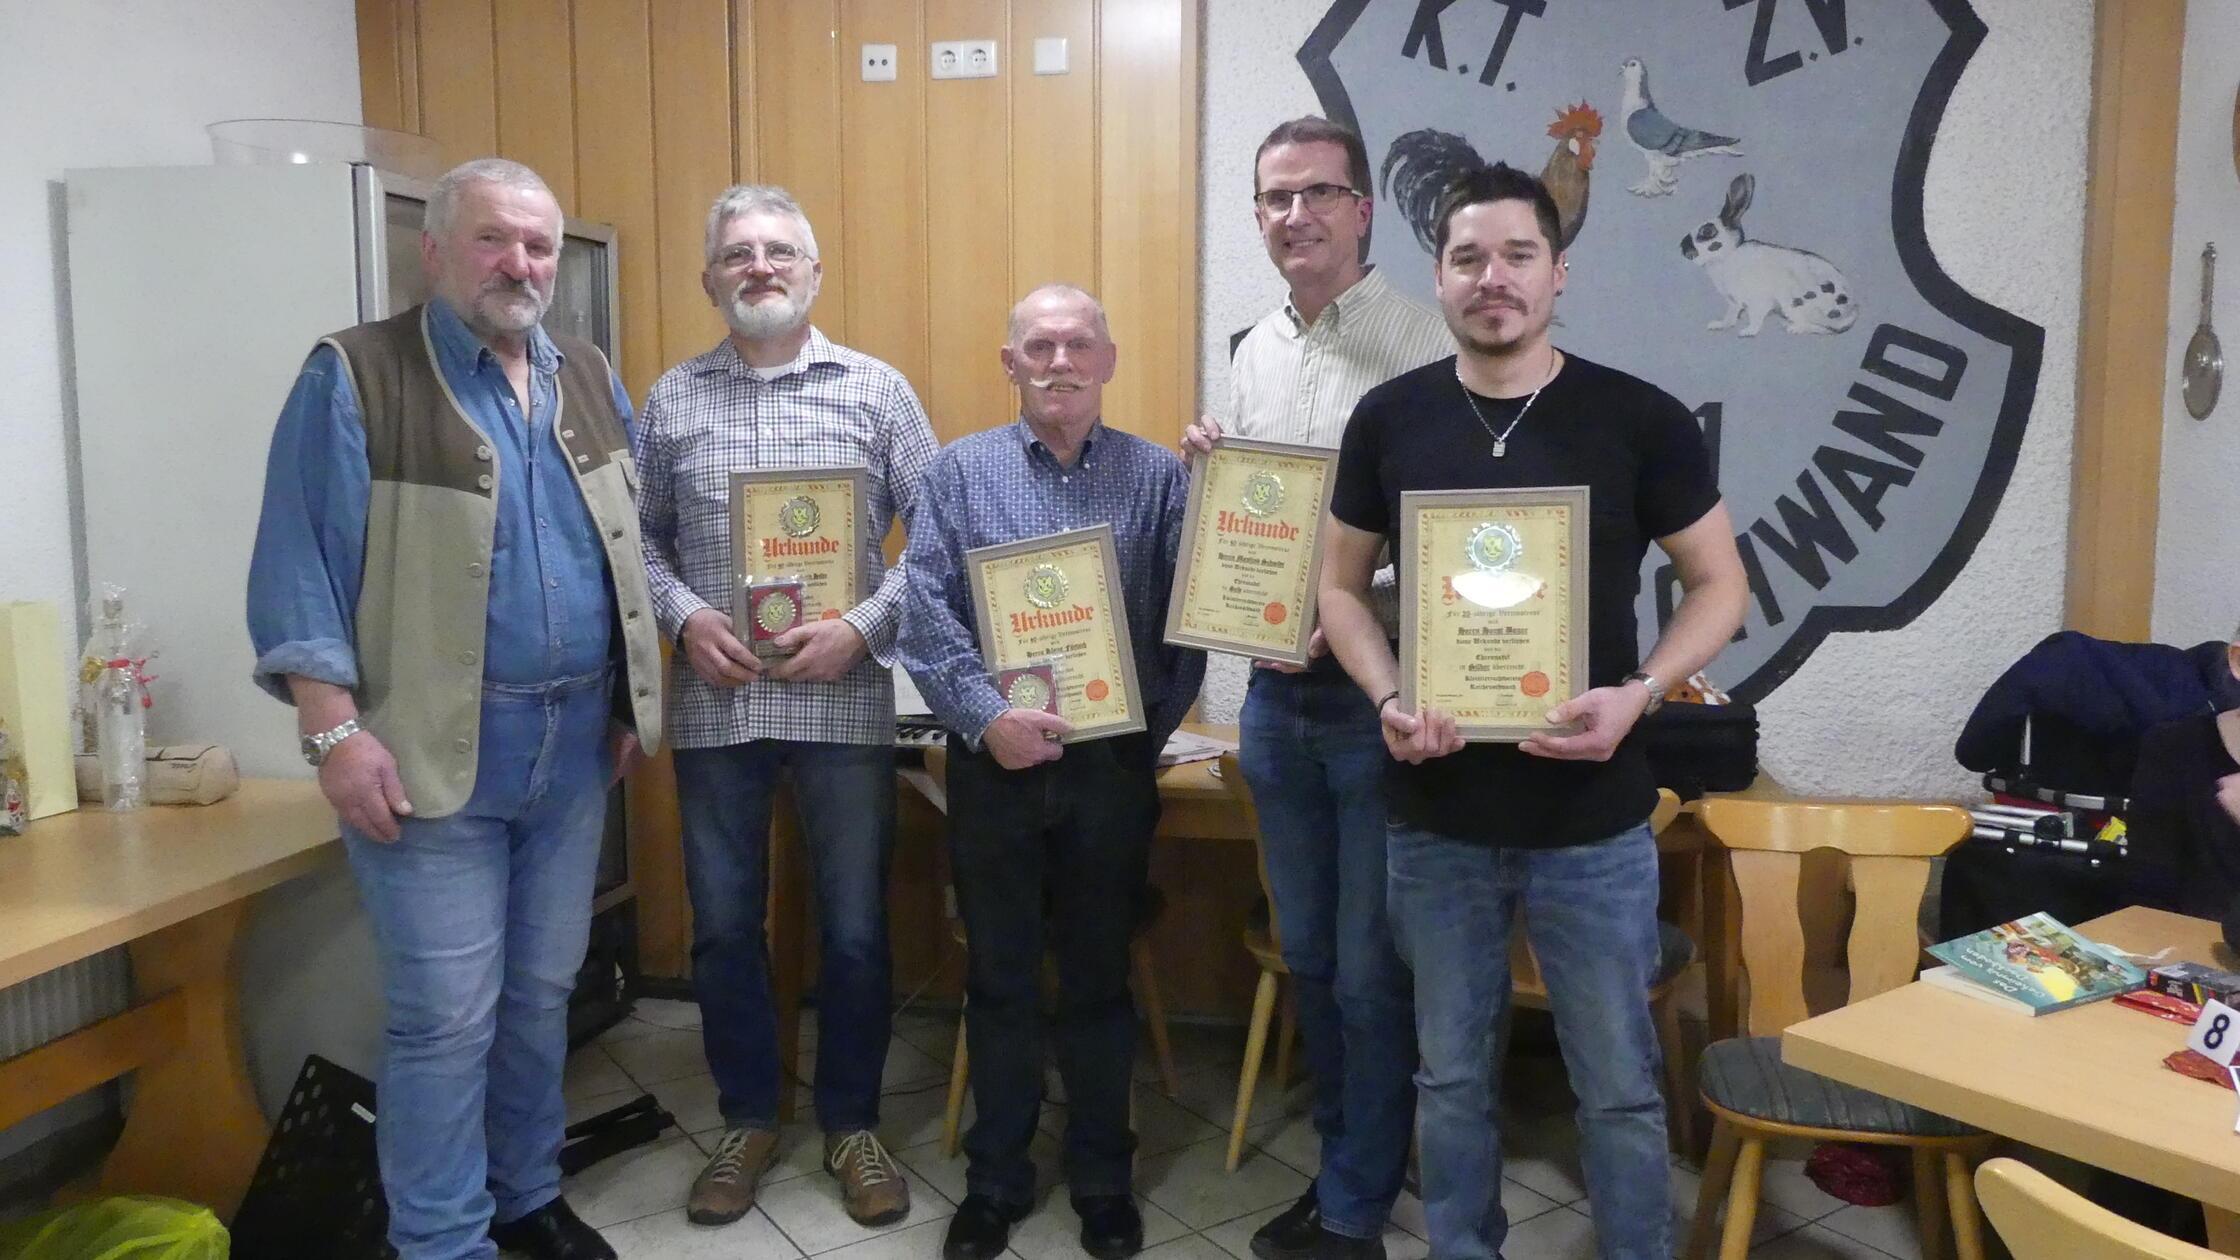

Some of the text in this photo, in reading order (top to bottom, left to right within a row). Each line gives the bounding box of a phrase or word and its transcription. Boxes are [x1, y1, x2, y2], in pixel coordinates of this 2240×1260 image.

[1216, 511, 1299, 541] Urkunde
[762, 536, 840, 562] Urkunde
[1009, 604, 1094, 637] Urkunde
[2203, 1013, 2231, 1050] 8
